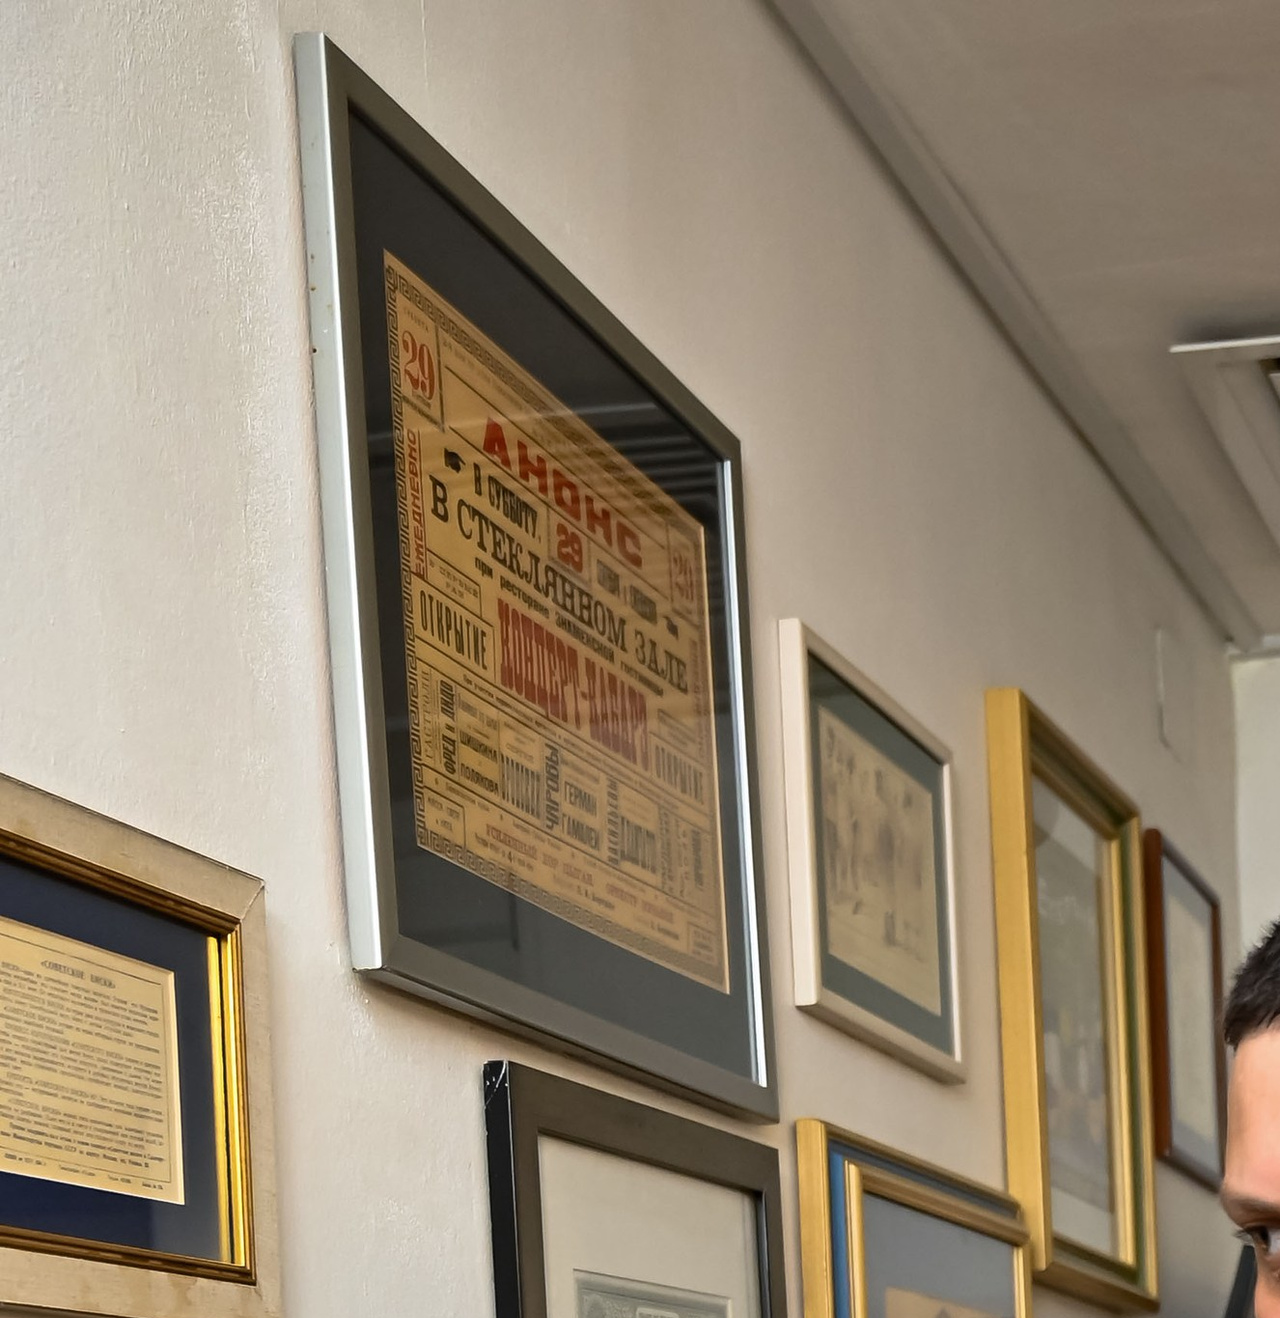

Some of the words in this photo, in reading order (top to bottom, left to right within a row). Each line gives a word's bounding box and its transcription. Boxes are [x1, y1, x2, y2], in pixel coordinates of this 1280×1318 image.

[402, 331, 435, 400] 29
[404, 425, 426, 580] ЕЖЕДНЕВНО
[472, 460, 482, 499] В
[556, 518, 584, 576] 29
[483, 417, 643, 568] АНОНС
[420, 590, 487, 670] ОТКРЫТИЕ
[428, 473, 450, 527] В
[455, 494, 630, 655] СТЕКЛЯННОМ
[634, 625, 688, 696] ЗАЛЕ
[474, 556, 494, 583] при
[499, 573, 550, 622] ресторане
[420, 667, 434, 765] ГАСТРОЛИ
[438, 677, 456, 722] ДИДО
[498, 598, 649, 772] КОНЦЕРТ-КАБАРЭ
[441, 732, 457, 778] ФРЕД
[541, 739, 563, 836] ЧАРОВЫ
